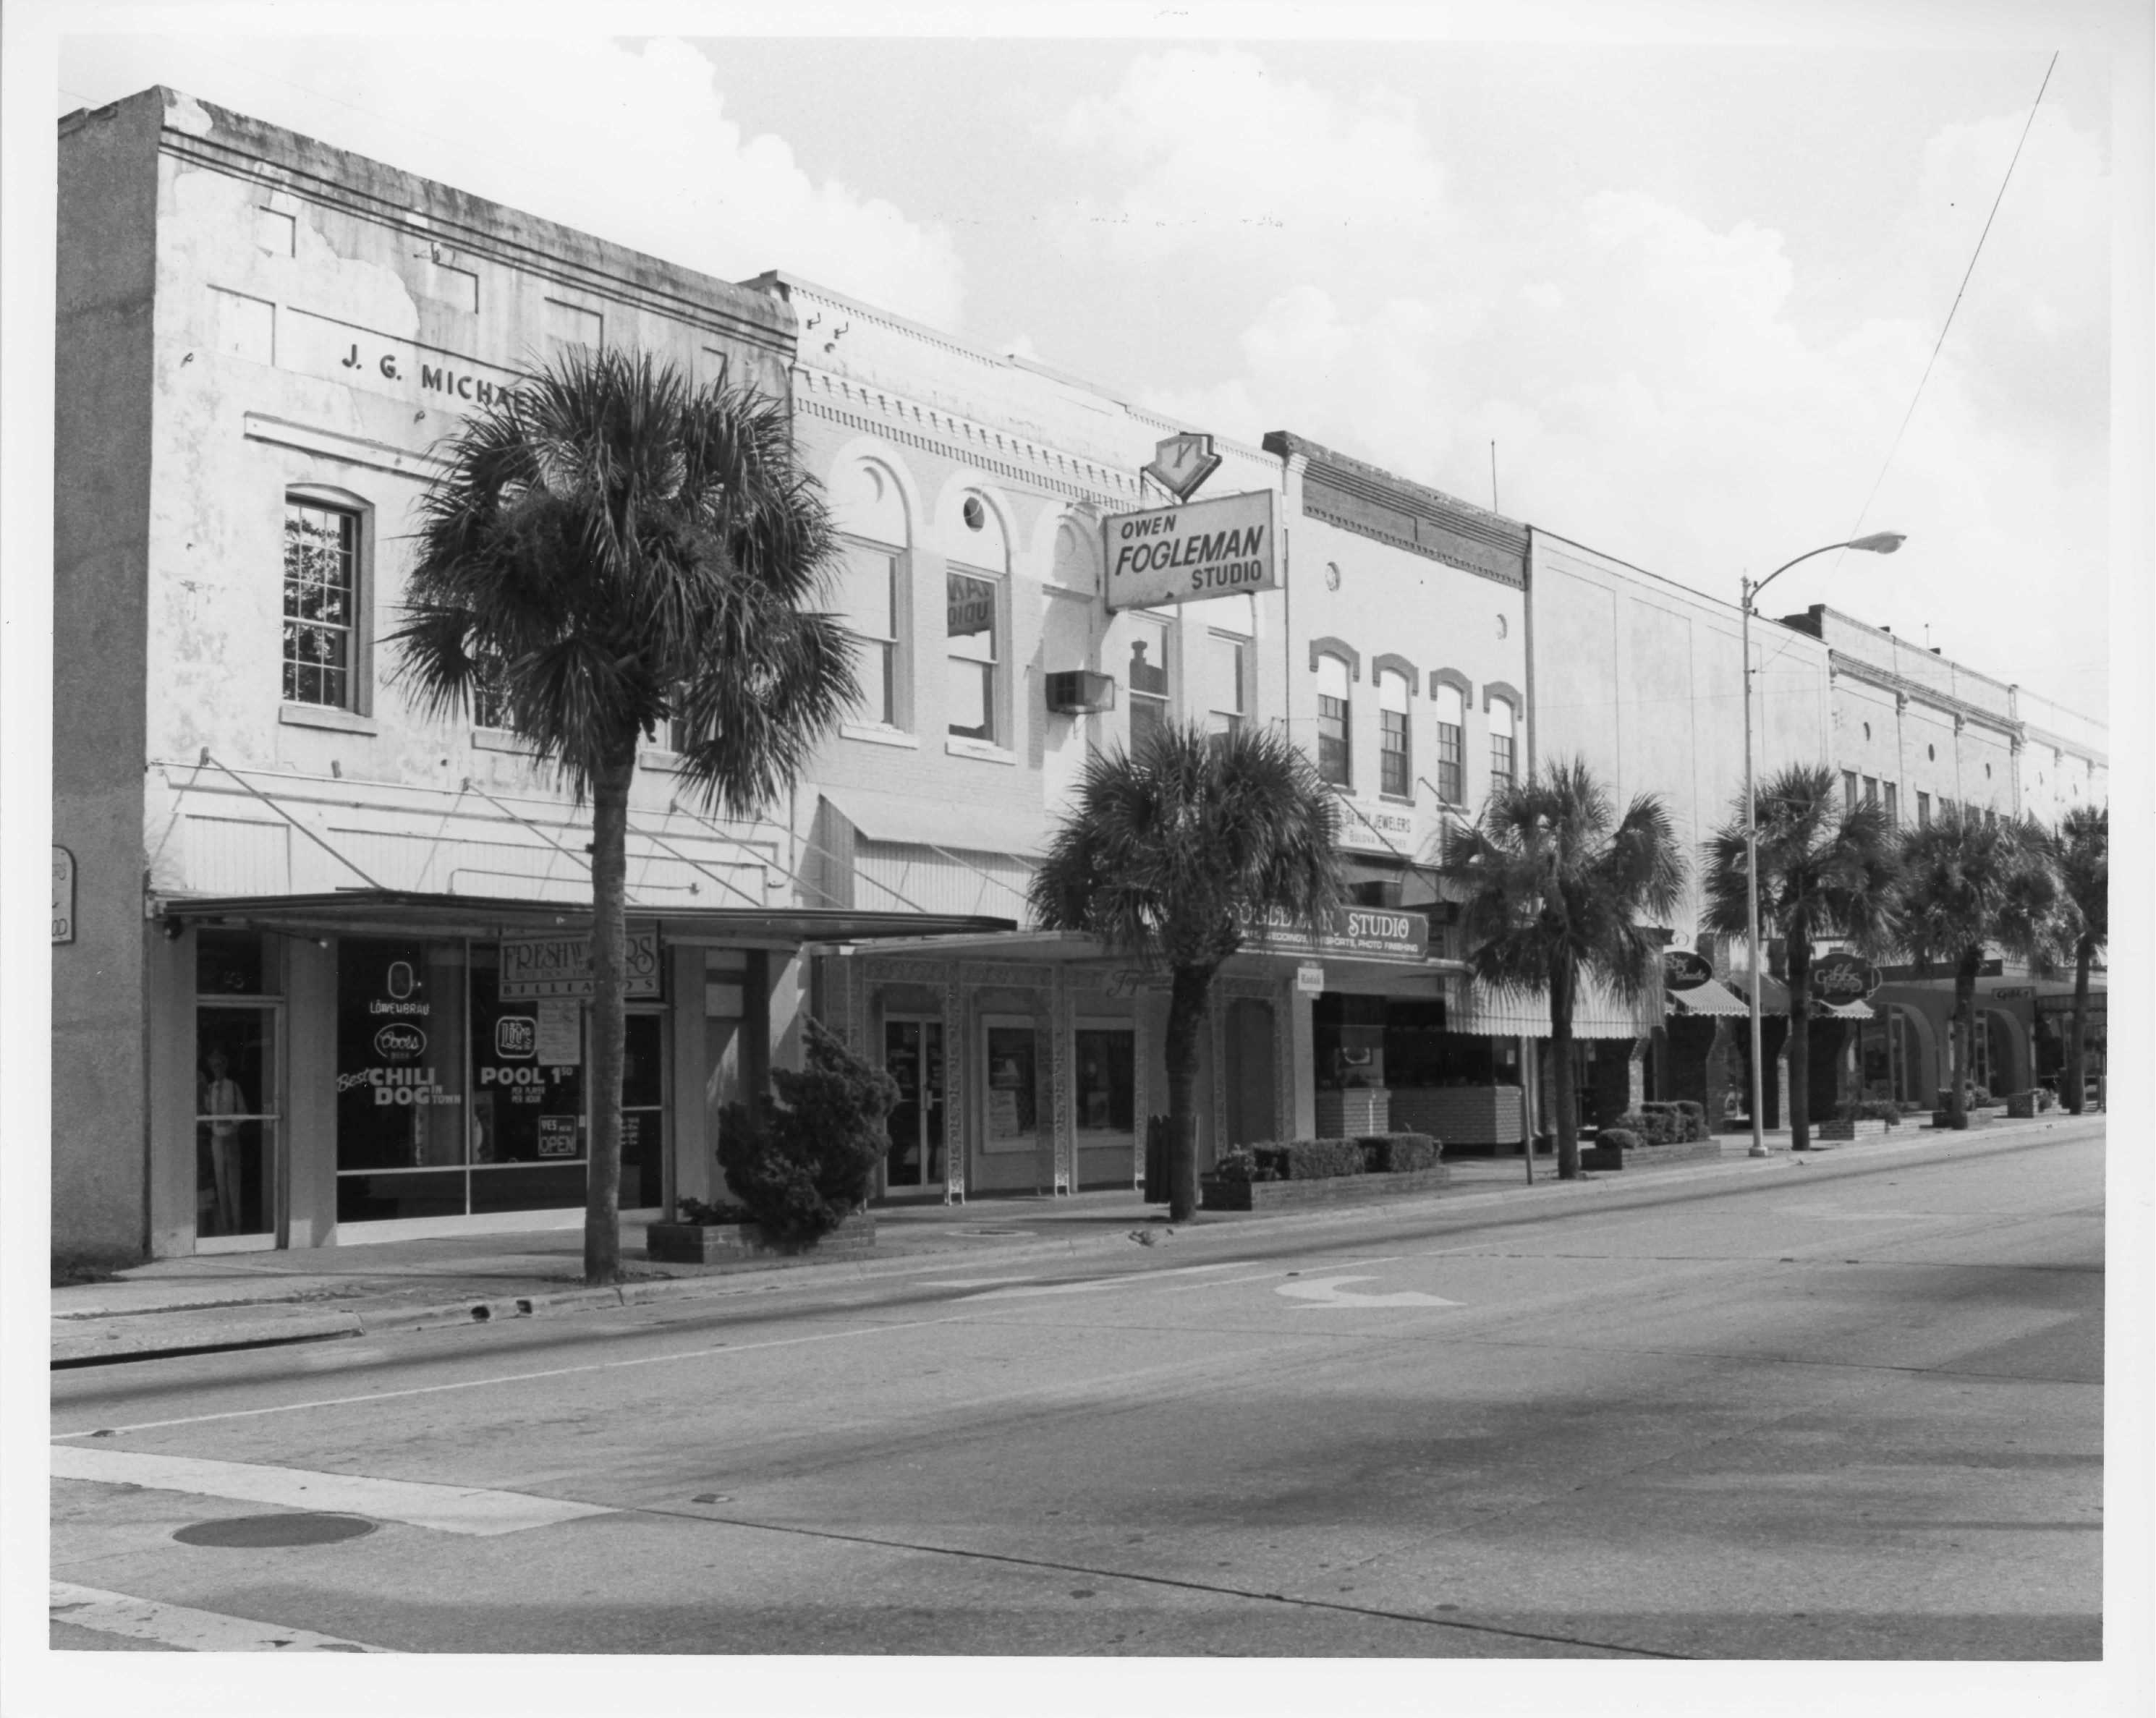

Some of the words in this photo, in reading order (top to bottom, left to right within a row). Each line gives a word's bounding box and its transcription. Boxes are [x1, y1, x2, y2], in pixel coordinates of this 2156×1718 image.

[341, 344, 362, 370] J.
[379, 354, 402, 380] G.
[1121, 514, 1177, 540] OWEN
[1115, 524, 1265, 577] FOGLEMAN
[1191, 560, 1262, 590] STUDIO
[1348, 913, 1409, 939] STUDIO
[1358, 940, 1383, 950] PHOTO
[1384, 941, 1418, 953] FINISHING
[380, 1031, 419, 1050] Coors
[336, 1068, 370, 1093] Best
[368, 1067, 435, 1086] CHILI
[480, 1067, 545, 1085] POOL
[375, 1086, 430, 1105] DOG
[432, 1094, 461, 1105] TOWN
[541, 1119, 557, 1131] YES
[540, 1134, 574, 1153] OPEN
